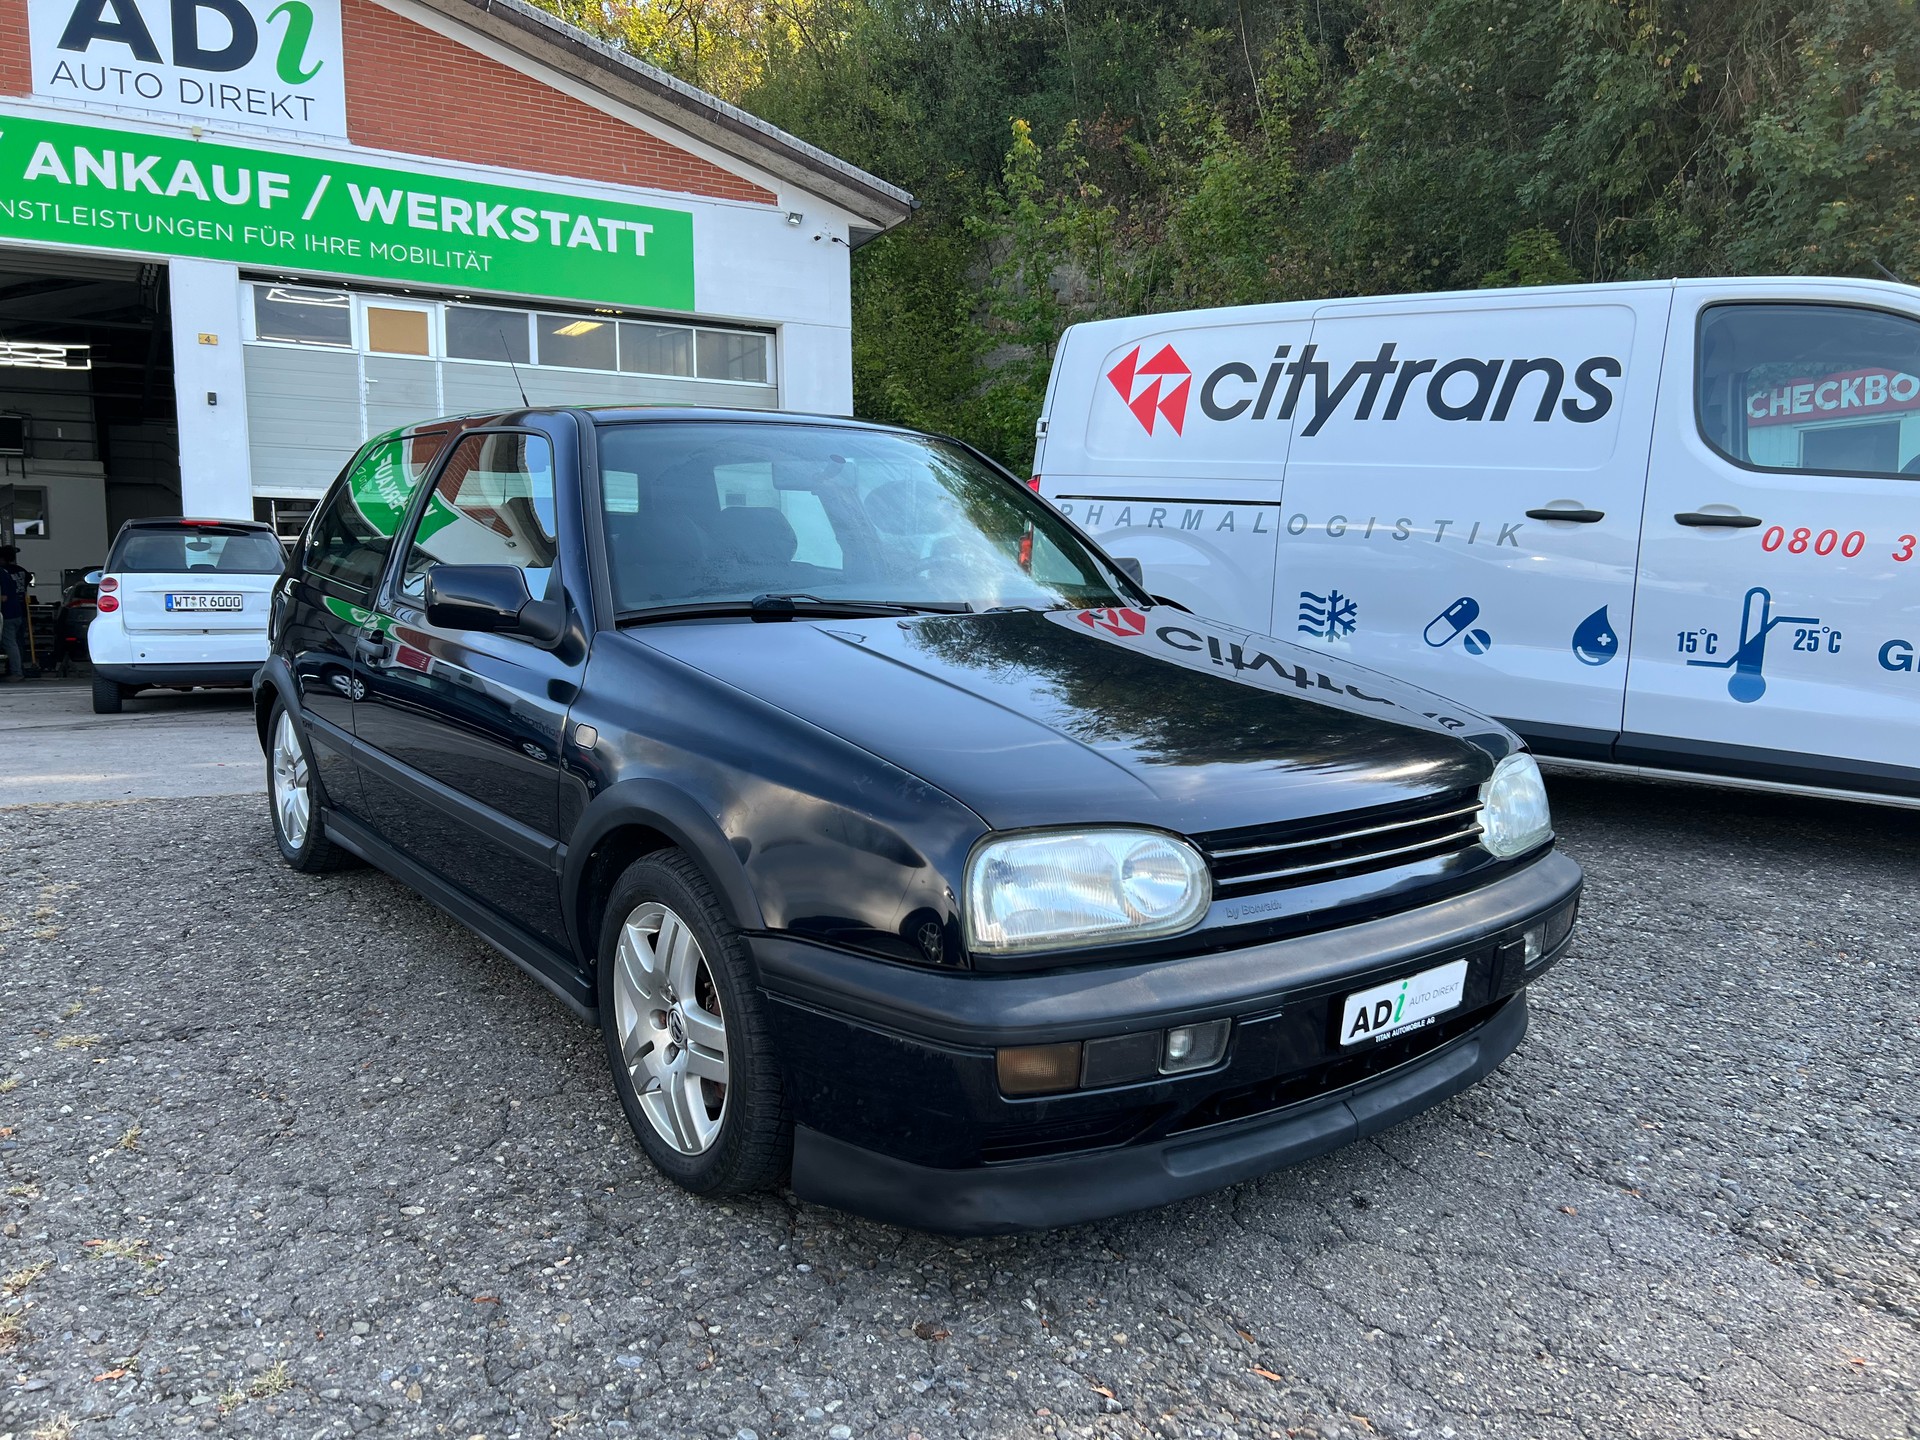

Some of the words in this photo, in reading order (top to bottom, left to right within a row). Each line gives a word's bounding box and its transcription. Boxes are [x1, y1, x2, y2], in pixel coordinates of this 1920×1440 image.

[50, 60, 163, 99] AUTO
[179, 78, 316, 121] DIREKT
[23, 141, 291, 209] ANKAUF
[301, 175, 332, 220] /
[346, 182, 654, 257] WERKSTATT
[244, 225, 296, 250] FÜR
[304, 234, 361, 258] IHRE
[371, 241, 493, 272] MOBILITÄT
[1200, 342, 1622, 437] citytrans
[1747, 372, 1920, 419] CHECKBO
[1059, 504, 1525, 547] PHARMALOGISTIK
[1761, 526, 1866, 558] 0800
[174, 596, 190, 607] WT
[199, 596, 207, 607] R
[210, 596, 241, 607] 6000
[1677, 628, 1718, 655] 15°C
[1793, 626, 1842, 654] 25°C
[1878, 639, 1920, 674] G
[1349, 981, 1408, 1039] ADi
[1409, 992, 1431, 1007] AUTO
[1432, 982, 1460, 999] DIREKT
[1375, 1031, 1391, 1043] TITAN
[1391, 1019, 1426, 1037] AUTOMOBILE
[1426, 1016, 1436, 1025] AG
